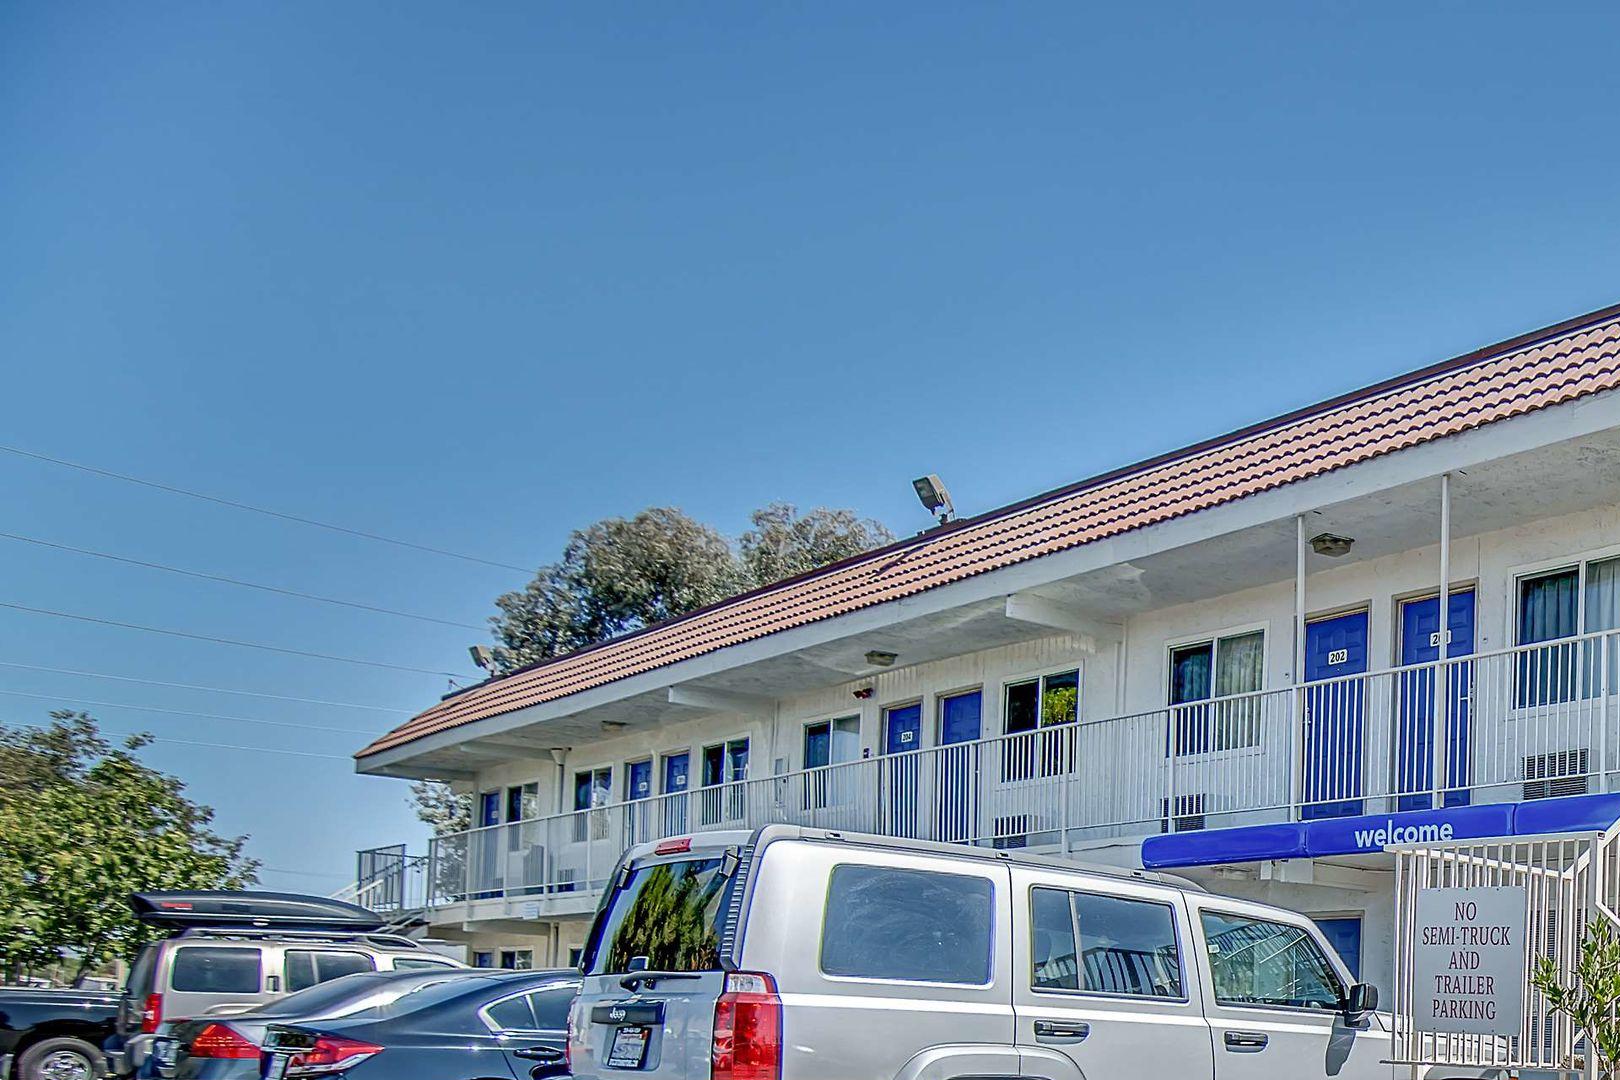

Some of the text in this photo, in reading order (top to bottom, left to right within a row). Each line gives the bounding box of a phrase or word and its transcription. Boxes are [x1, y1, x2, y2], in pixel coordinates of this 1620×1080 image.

[1330, 651, 1346, 663] 202
[1354, 819, 1454, 848] welcome
[1455, 901, 1477, 921] NO
[1422, 926, 1511, 946] SEMI-TRUCK
[1448, 951, 1480, 970] AND
[1434, 975, 1495, 995] TRAILER
[1432, 999, 1497, 1020] PARKING
